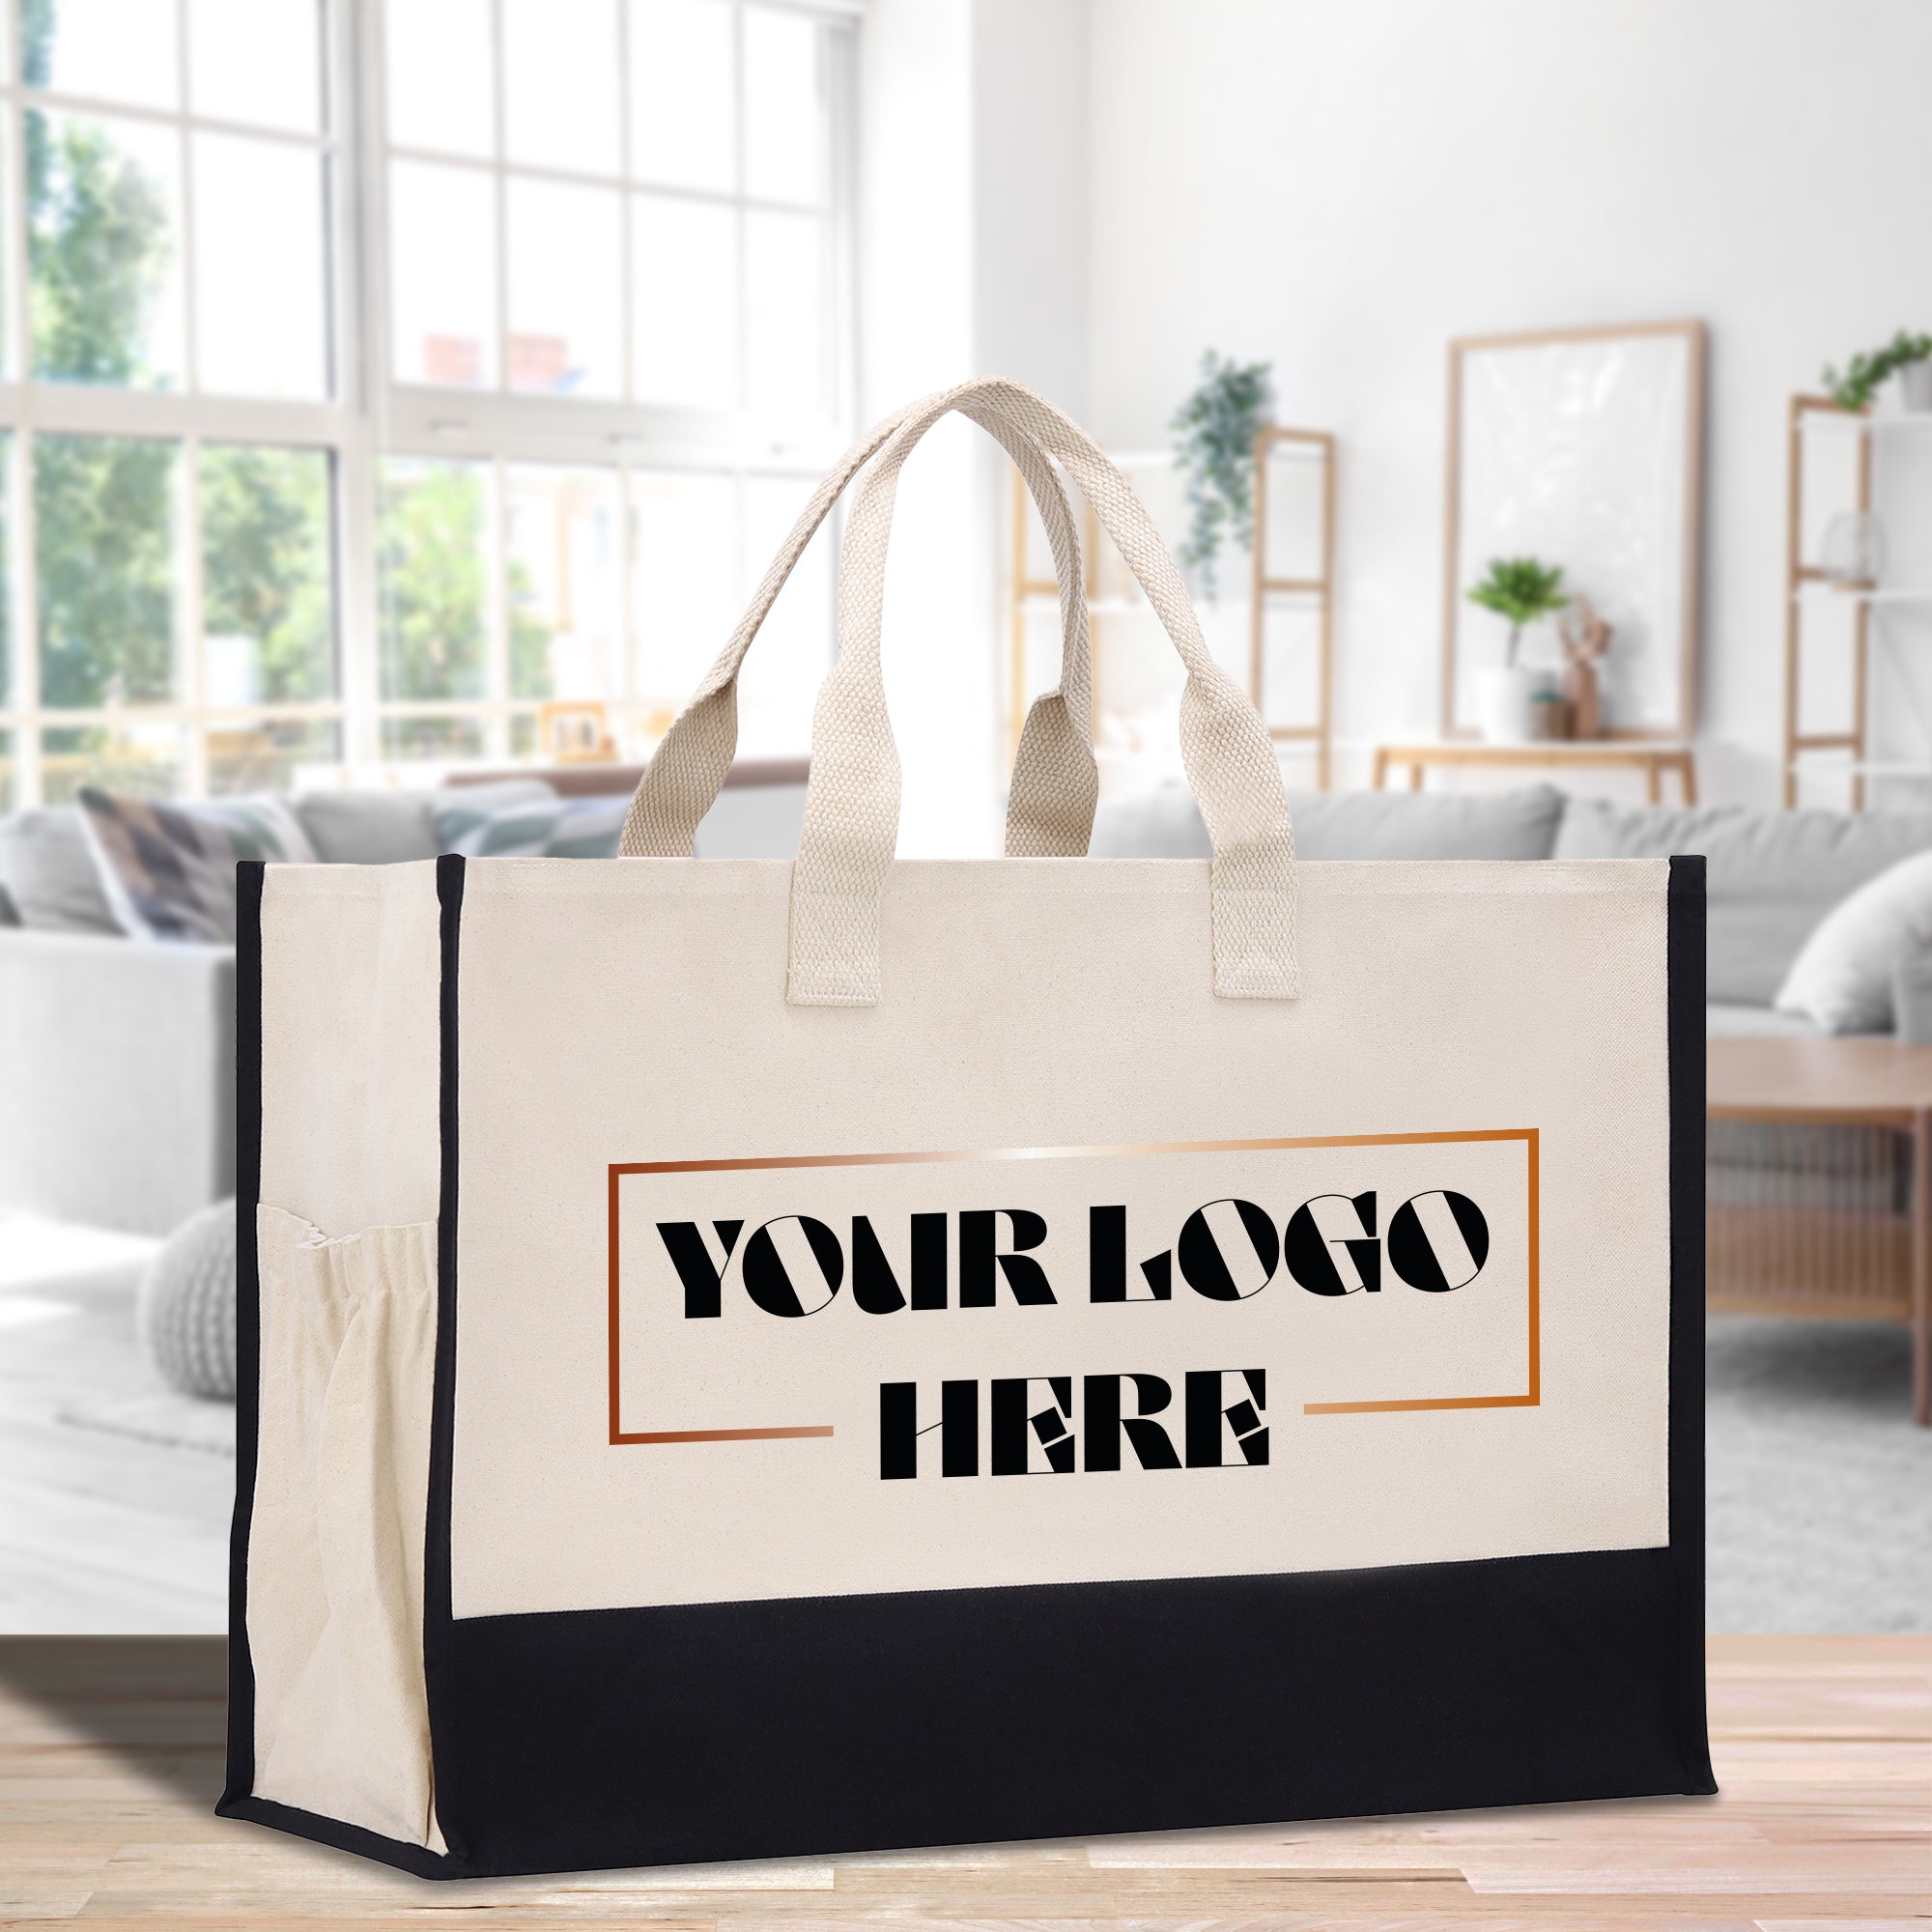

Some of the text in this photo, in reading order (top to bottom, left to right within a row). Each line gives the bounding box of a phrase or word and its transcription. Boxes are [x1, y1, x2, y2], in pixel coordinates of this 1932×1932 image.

[656, 1190, 1489, 1319] YOUR LOGO
[880, 1369, 1268, 1480] HERE
